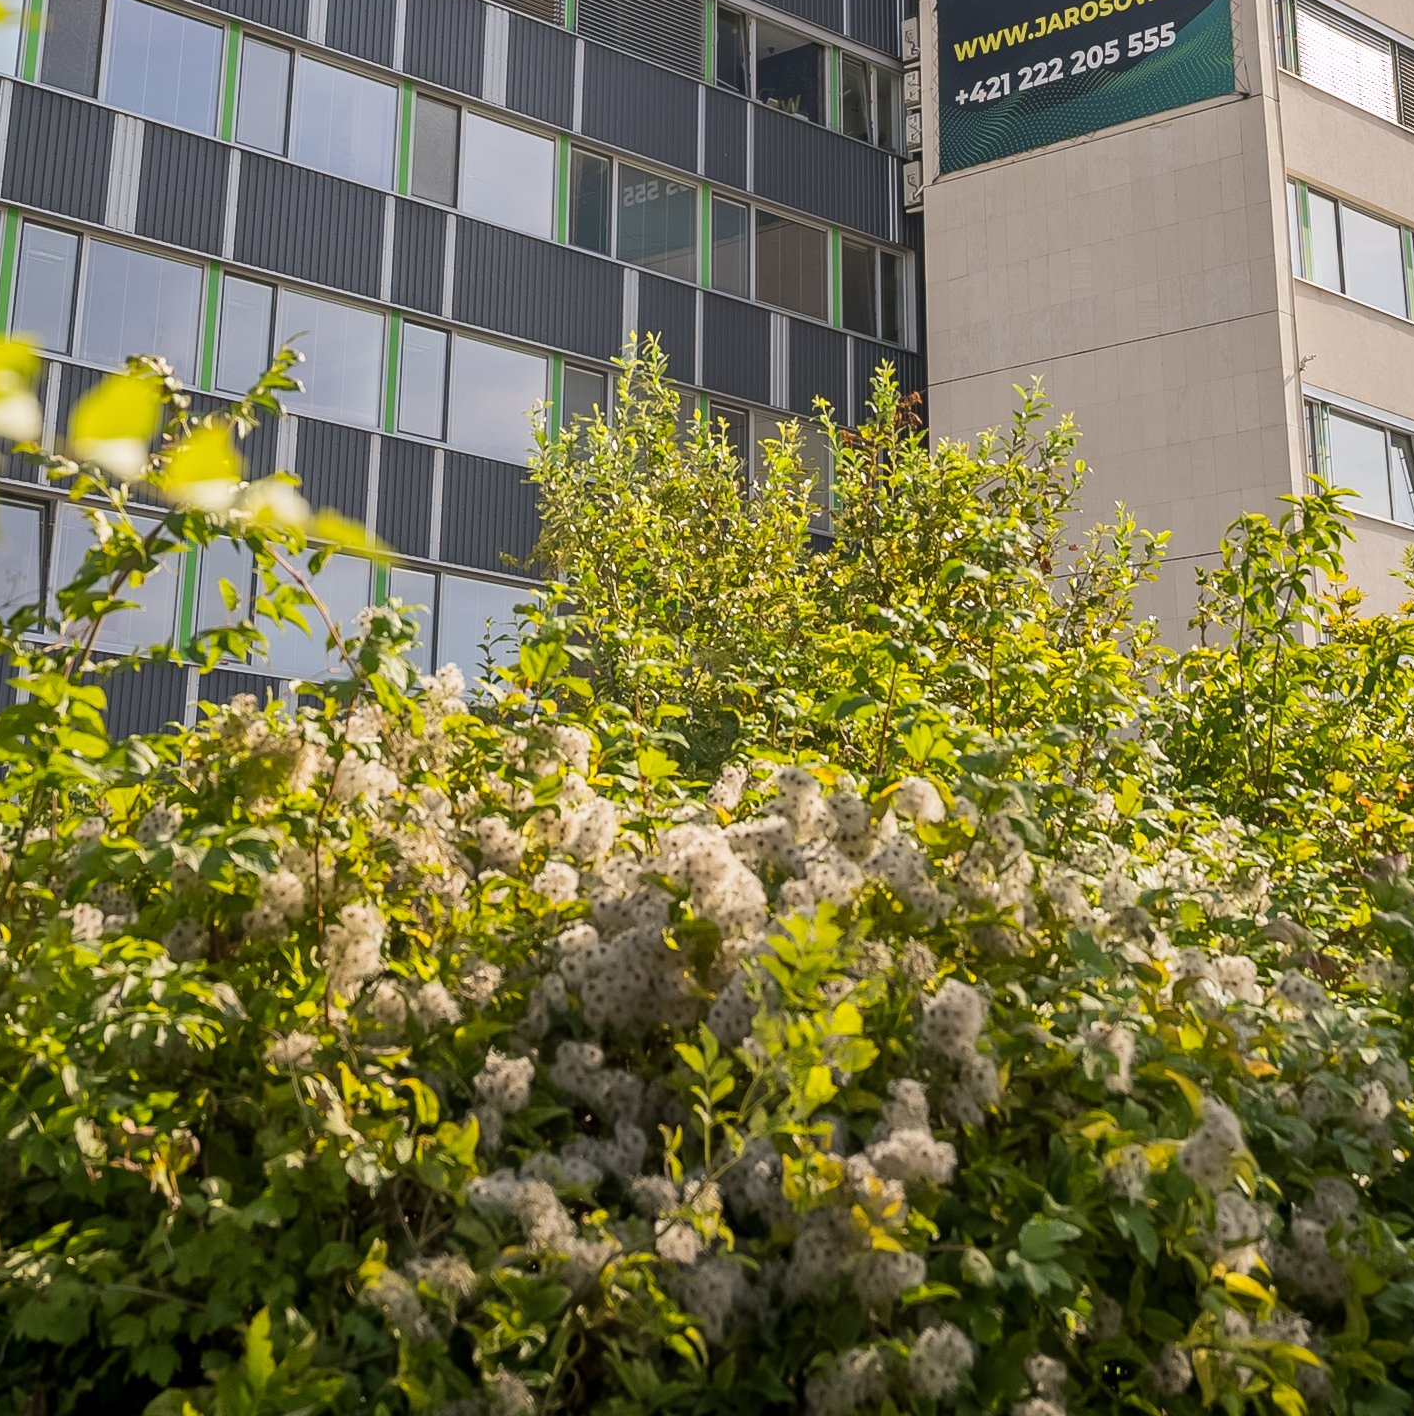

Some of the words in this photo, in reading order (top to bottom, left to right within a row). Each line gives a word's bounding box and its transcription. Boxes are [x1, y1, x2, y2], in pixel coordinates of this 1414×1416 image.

[955, 73, 1011, 105] +421
[1018, 57, 1064, 91] 222
[1070, 39, 1119, 75] 205
[1128, 22, 1176, 58] 555
